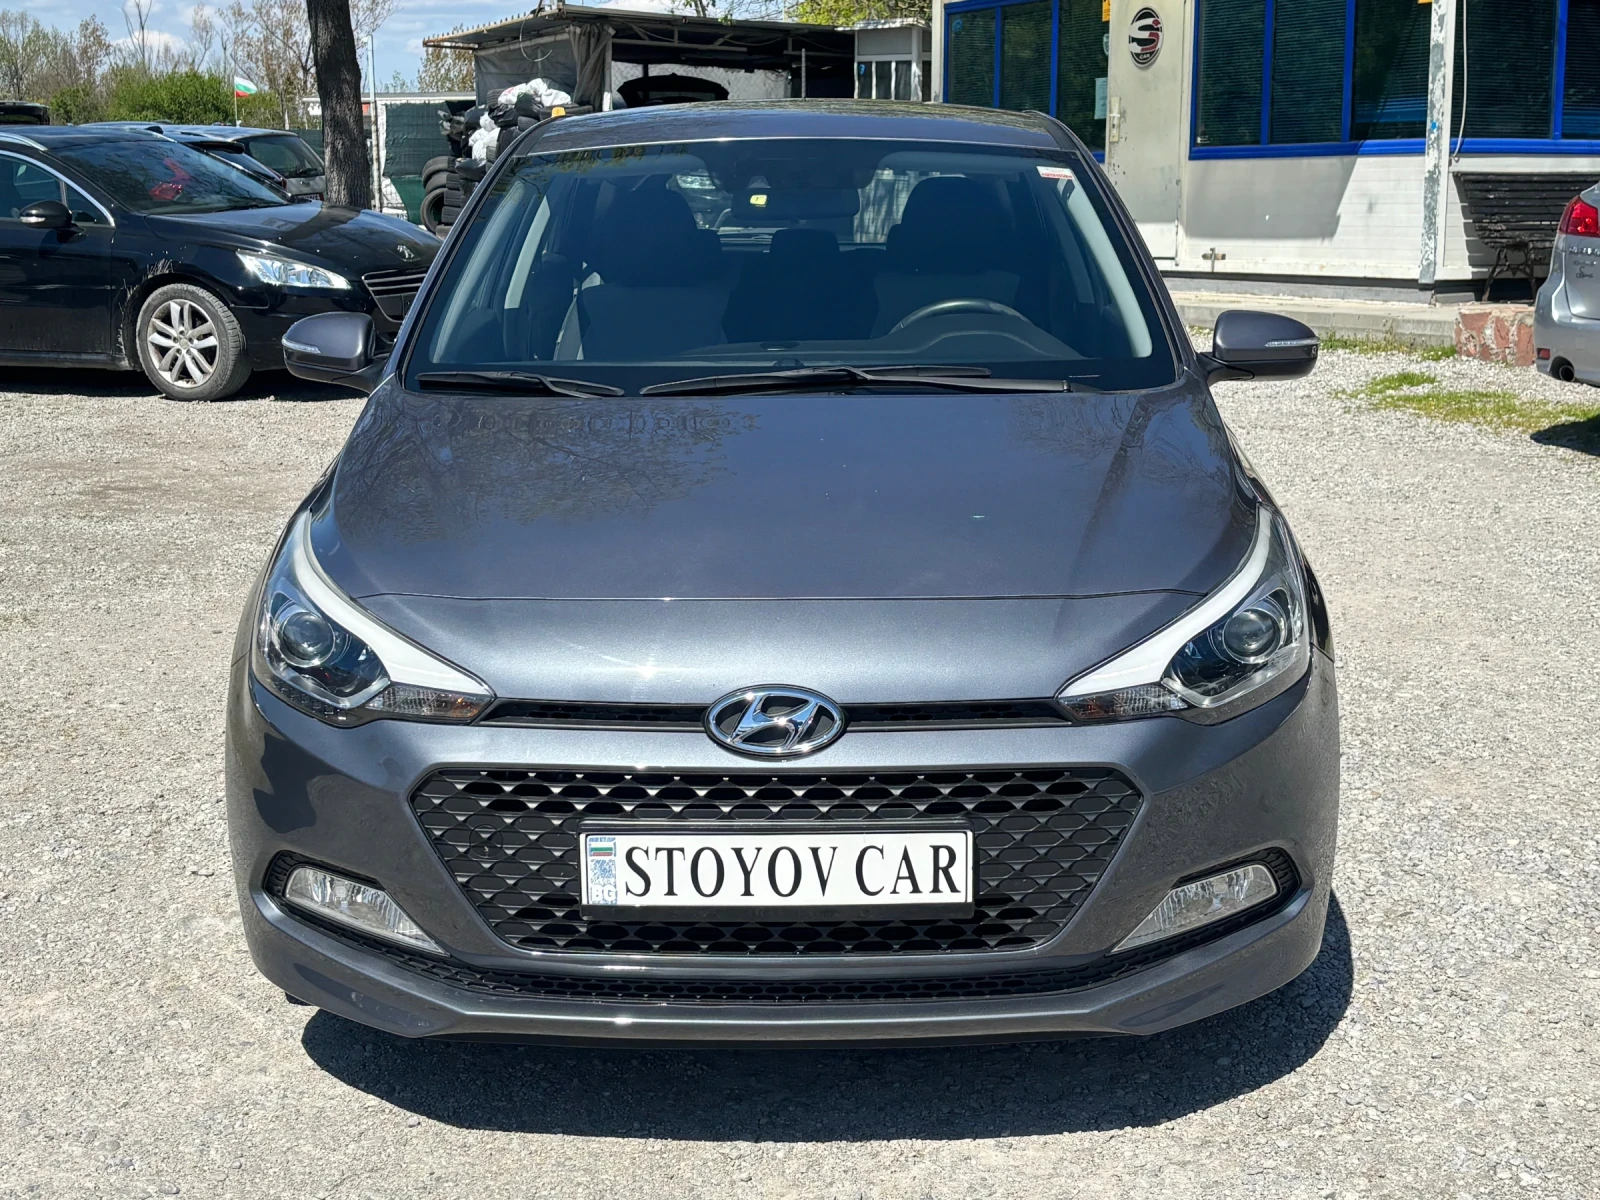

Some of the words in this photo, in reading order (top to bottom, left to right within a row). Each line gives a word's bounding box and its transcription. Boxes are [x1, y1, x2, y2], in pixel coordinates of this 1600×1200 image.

[625, 846, 838, 897] STOYOV
[855, 844, 961, 896] CAR
[592, 885, 617, 901] BG
